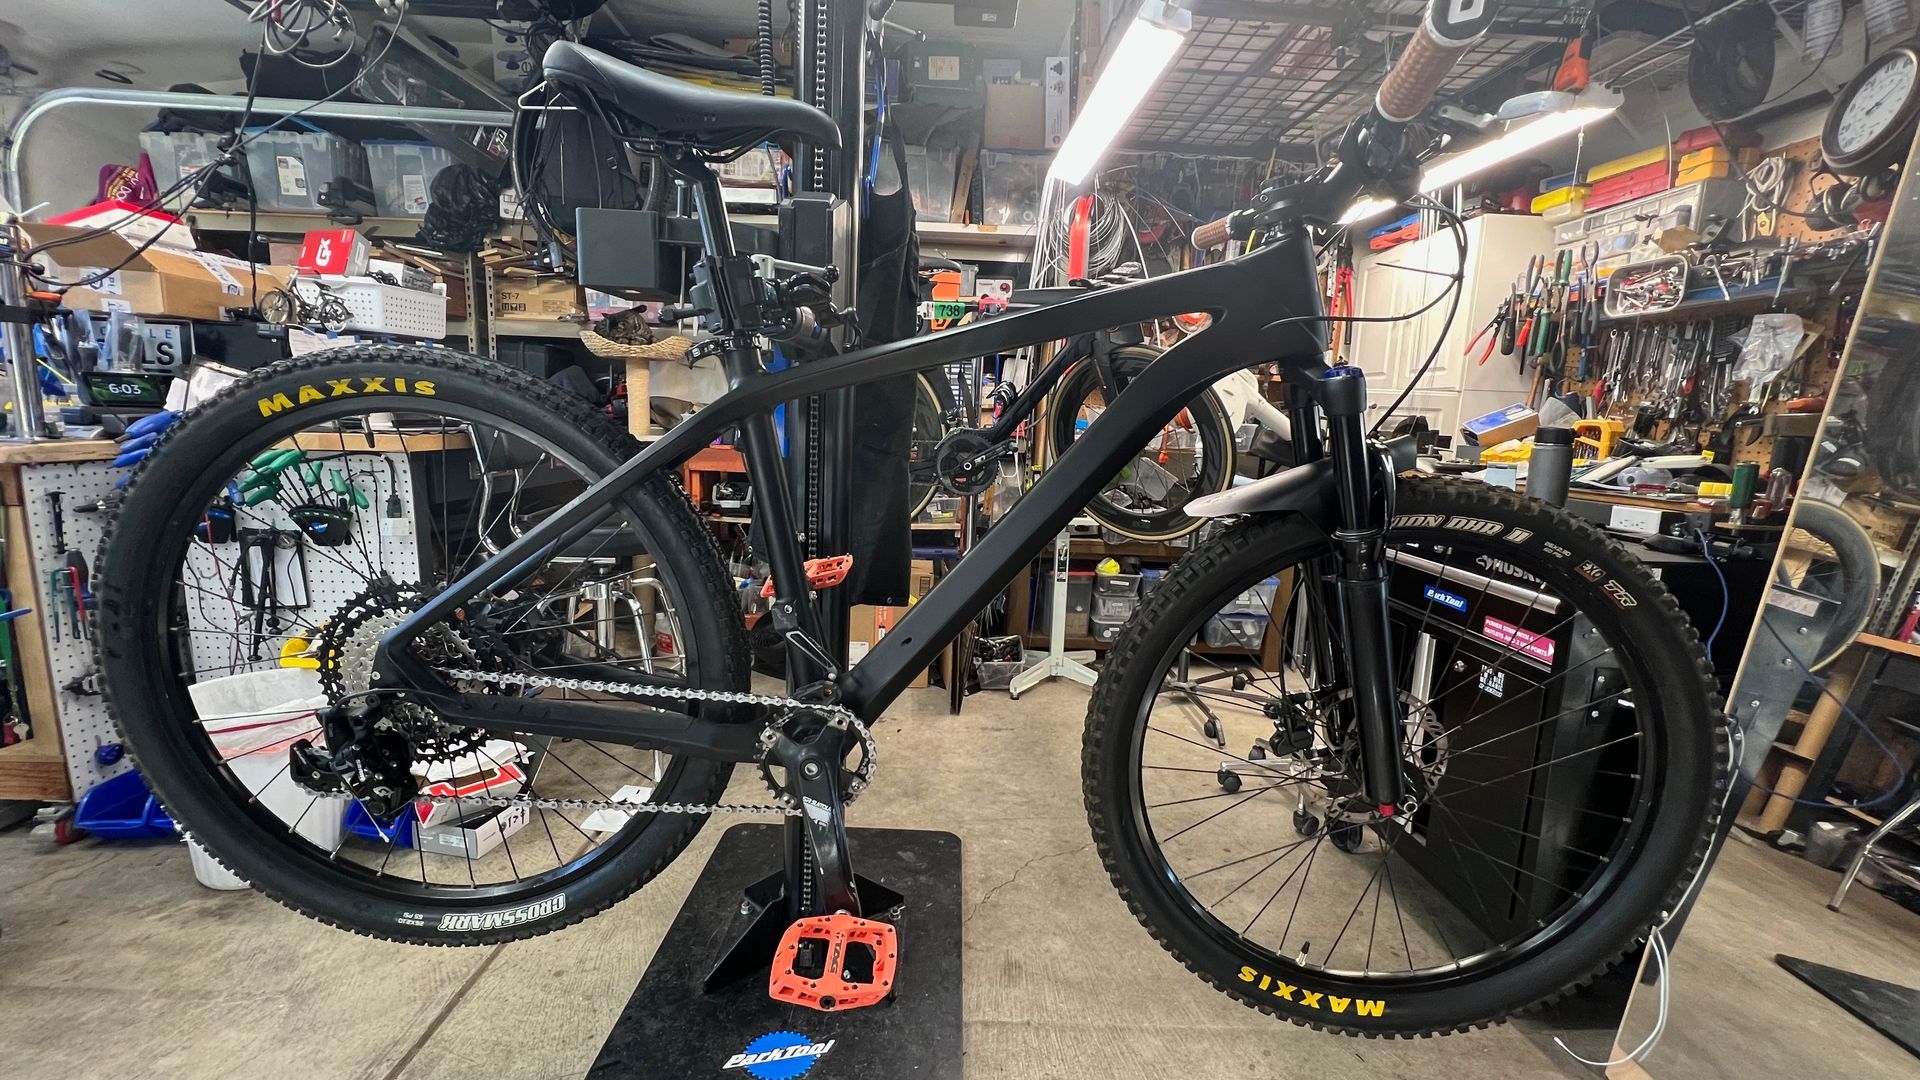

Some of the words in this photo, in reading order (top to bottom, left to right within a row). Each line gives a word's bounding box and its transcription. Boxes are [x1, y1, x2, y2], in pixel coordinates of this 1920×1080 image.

[501, 292, 520, 300] ST-7
[940, 304, 960, 317] 738
[108, 383, 141, 395] 6:03
[257, 377, 436, 417] MAXXIS
[1443, 515, 1505, 536] DHR
[1491, 557, 1542, 584] HUSK
[1581, 561, 1604, 578] EXO
[1603, 579, 1638, 607] TR
[1485, 618, 1503, 630] POWER
[1484, 626, 1504, 639] OUTLETS
[1530, 645, 1548, 657] PORTS
[437, 893, 566, 932] CROSSMARK
[1237, 965, 1386, 1017] MAXXIS
[722, 1039, 836, 1070] ParkTool
